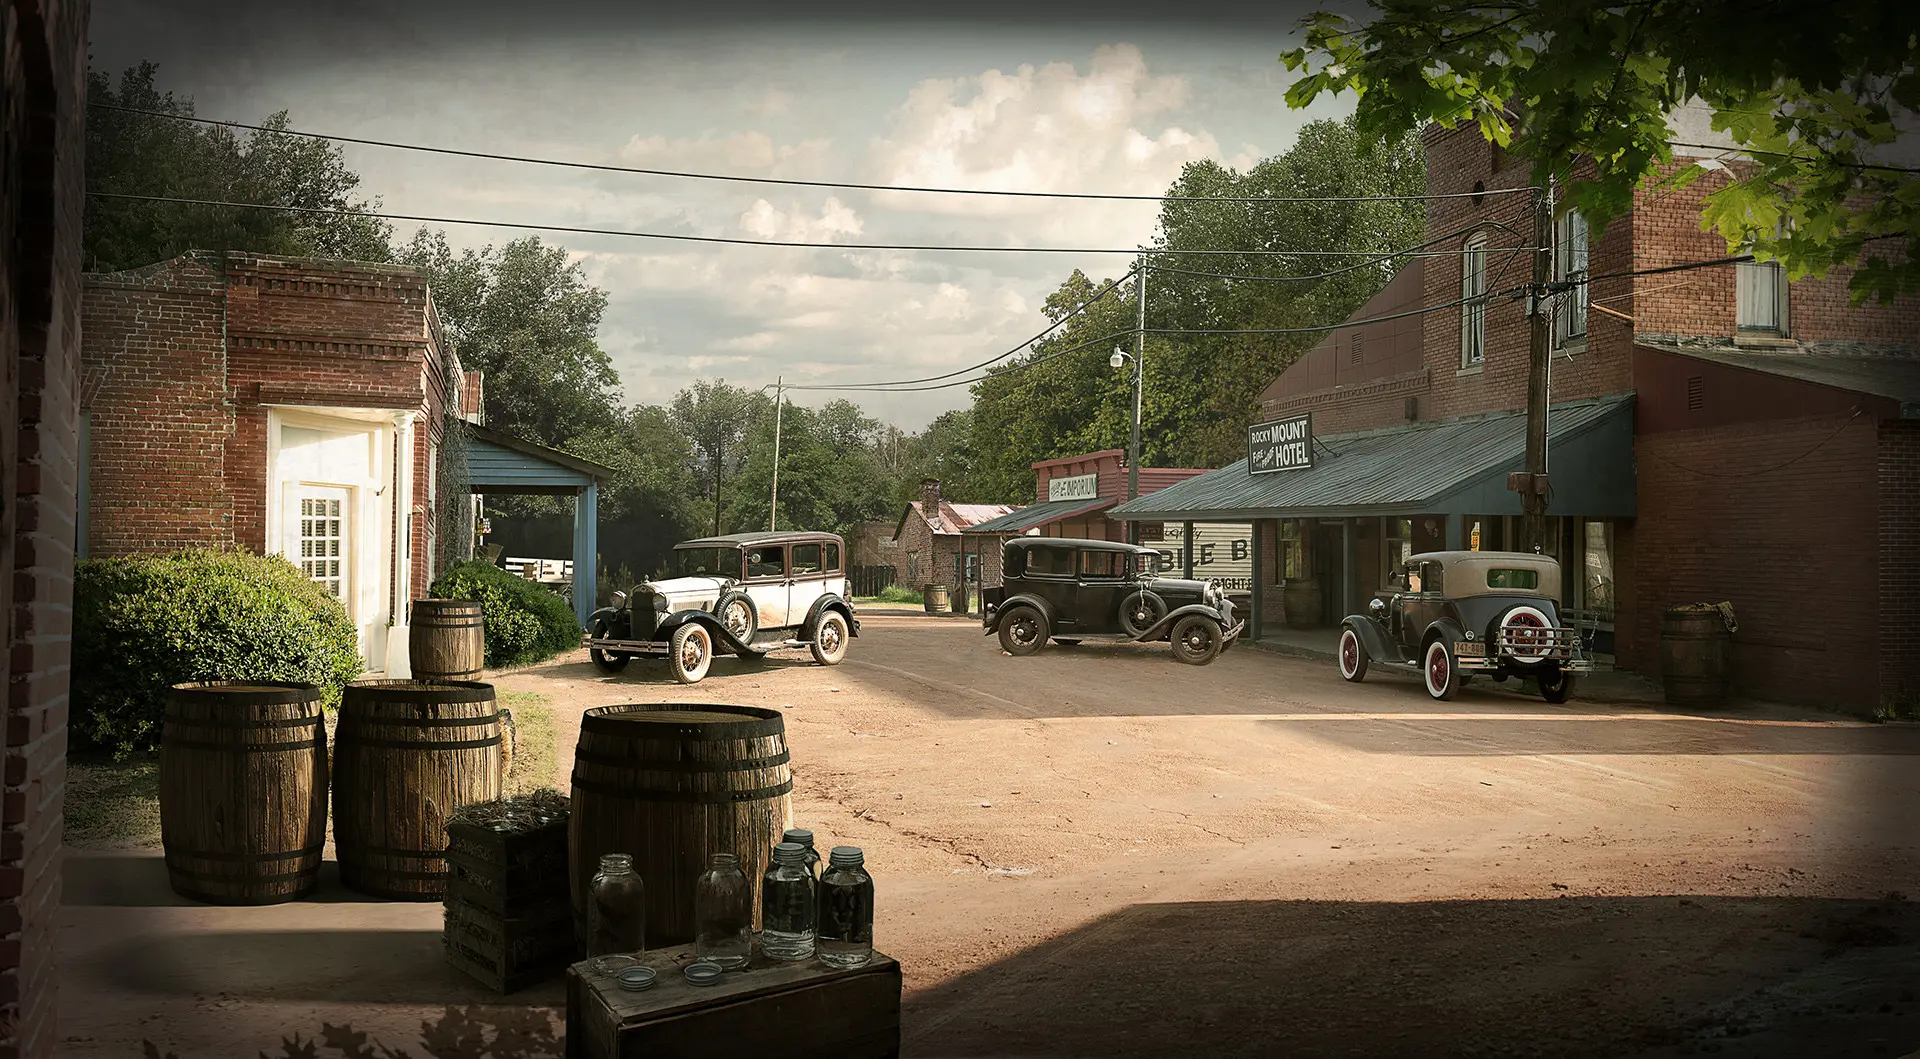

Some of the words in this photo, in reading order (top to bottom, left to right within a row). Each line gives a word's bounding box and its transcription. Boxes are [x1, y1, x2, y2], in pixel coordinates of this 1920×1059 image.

[1251, 429, 1271, 444] ROCKY
[1271, 420, 1307, 443] MOUNT
[1275, 441, 1309, 467] HOTEL
